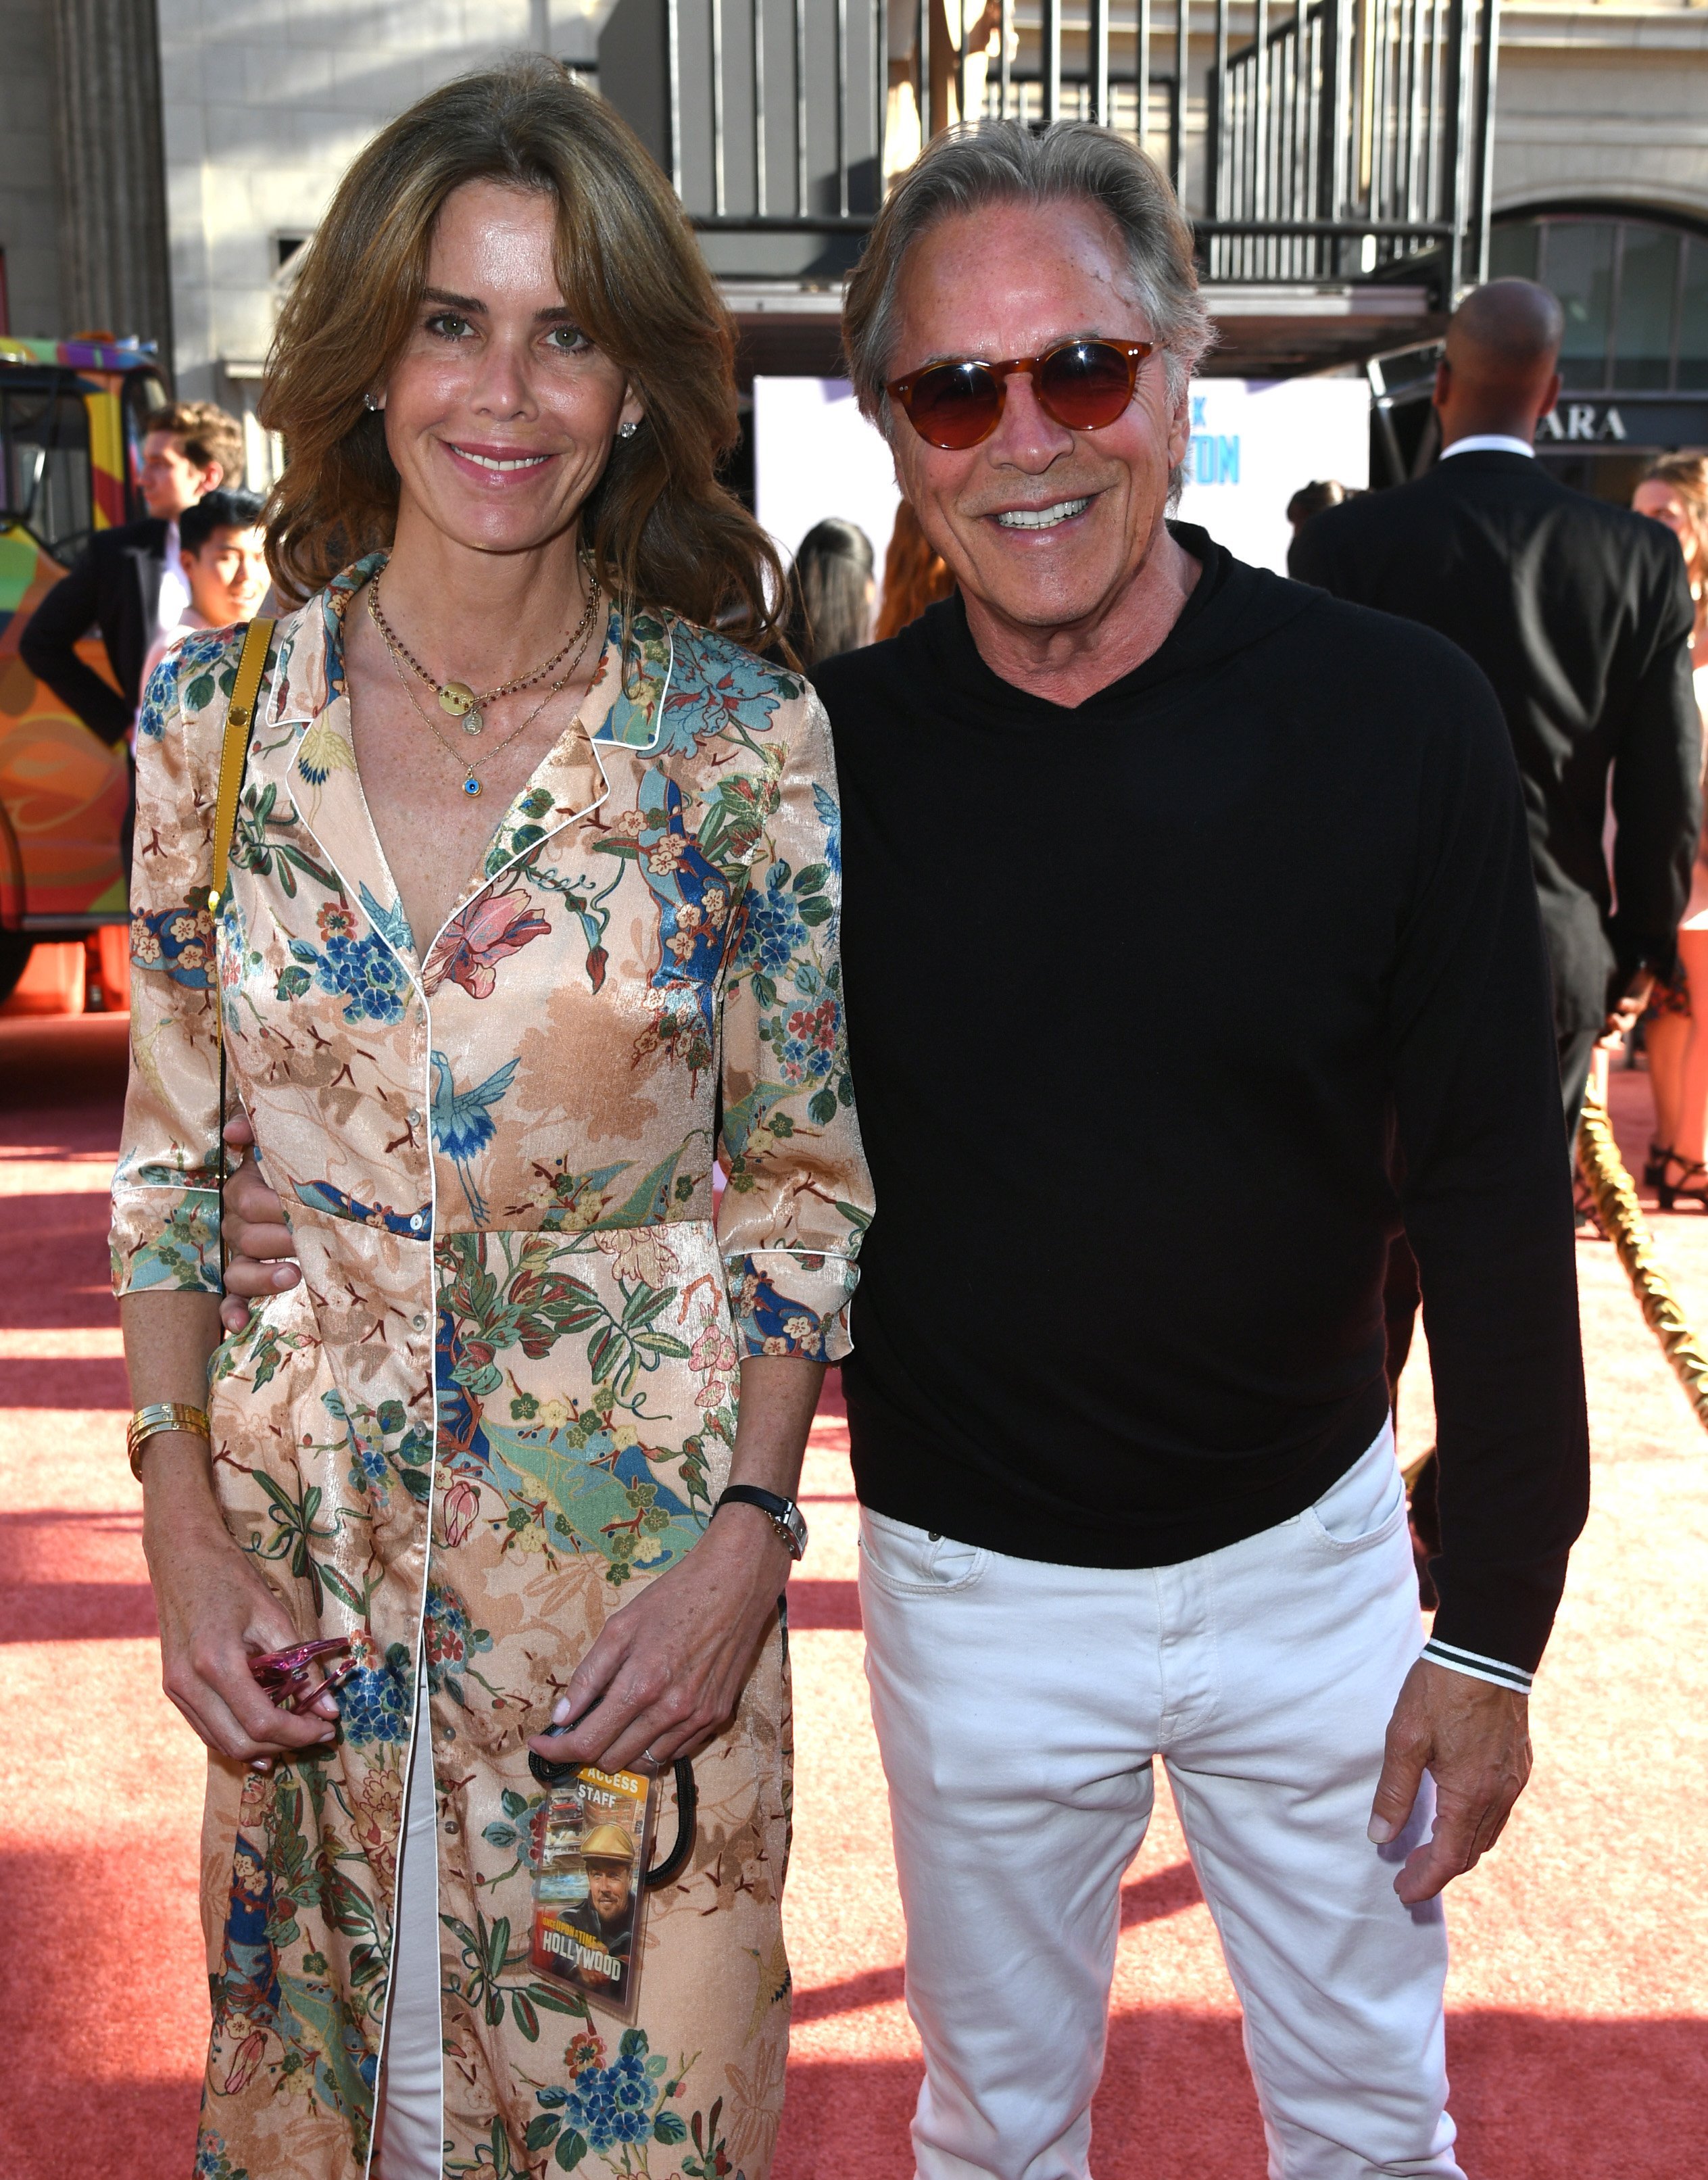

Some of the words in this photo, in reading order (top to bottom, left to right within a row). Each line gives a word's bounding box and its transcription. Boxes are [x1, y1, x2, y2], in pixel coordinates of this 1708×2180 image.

[587, 1768, 638, 1793] ACCESS
[578, 1785, 616, 1808] STAFF
[543, 1917, 556, 1929] ONCE
[556, 1920, 575, 1937] UPON
[579, 1931, 597, 1948] TIME
[543, 1931, 621, 1981] HOLLYWOOD
